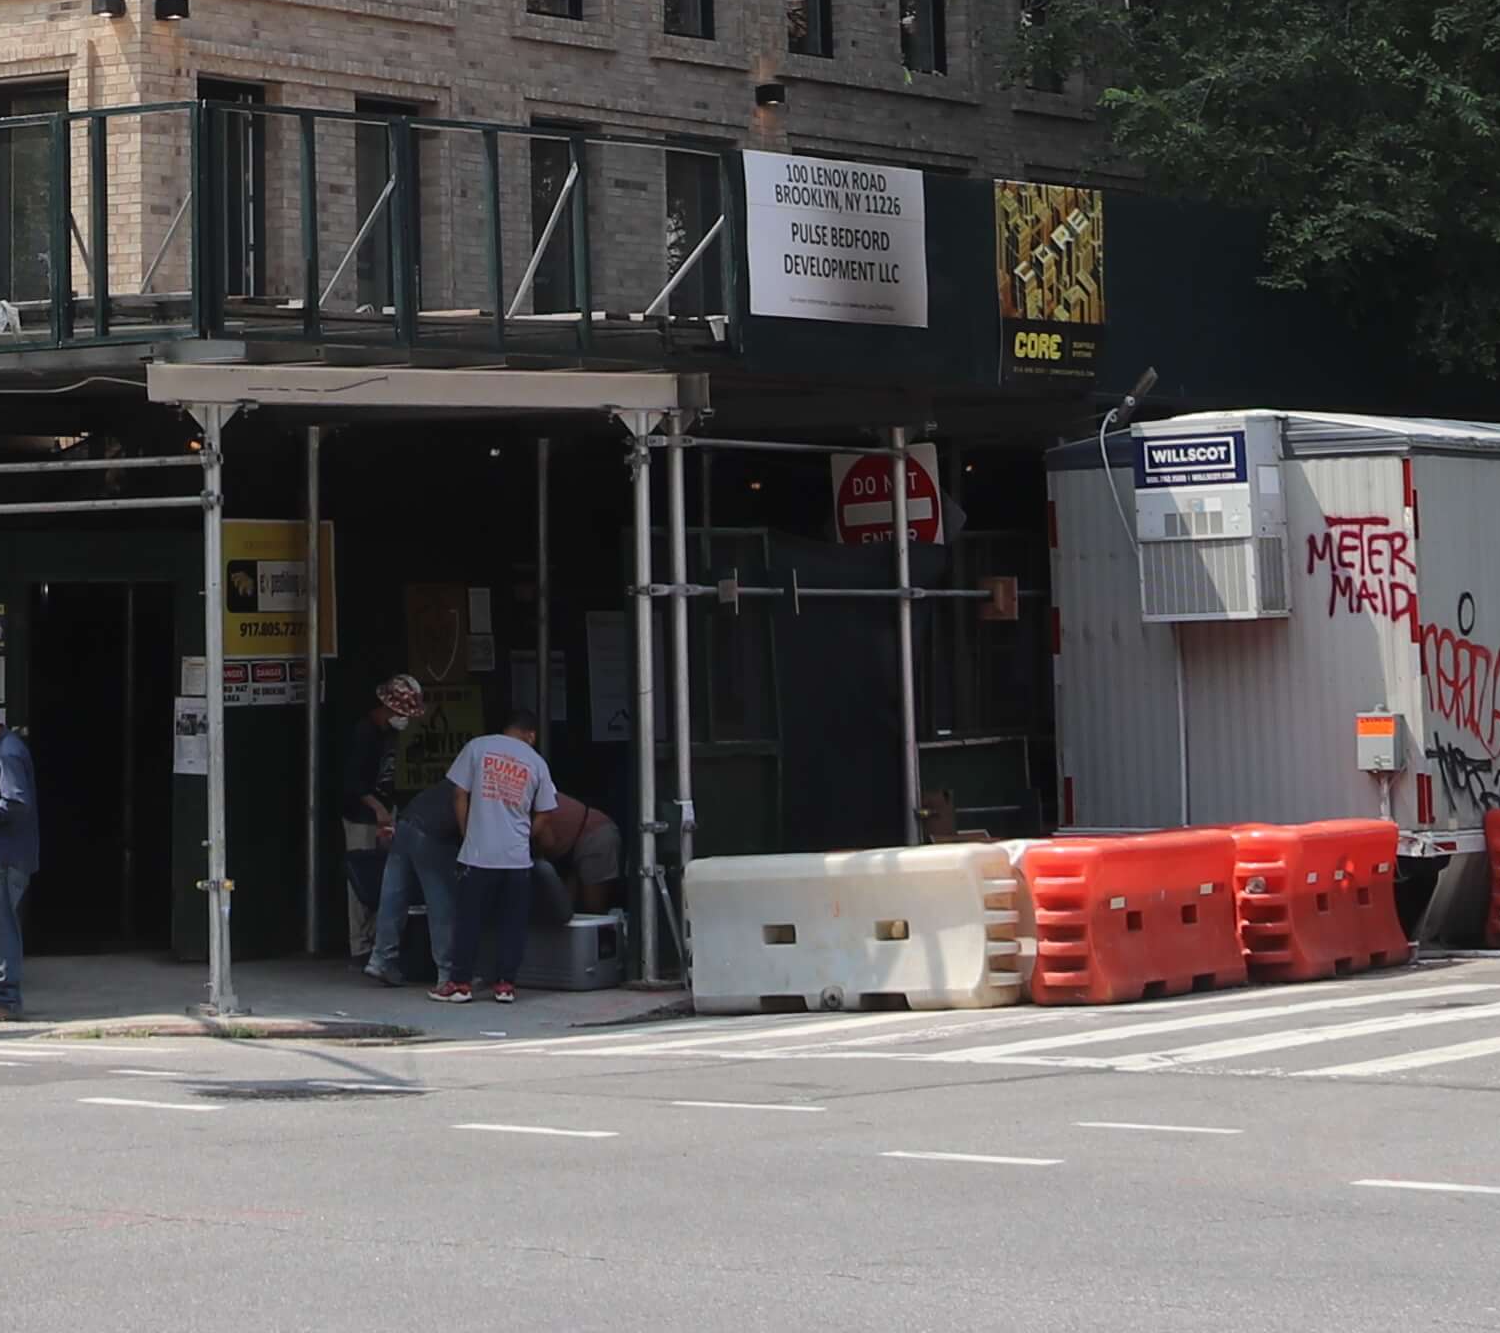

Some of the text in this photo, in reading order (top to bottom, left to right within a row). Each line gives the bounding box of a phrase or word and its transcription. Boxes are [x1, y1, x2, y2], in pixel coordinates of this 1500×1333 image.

[786, 163, 888, 193] 100 LENOX ROAD
[774, 183, 902, 217] BROOKLYN, NY 11226
[791, 222, 891, 252] PULSE BEDFORD
[783, 253, 901, 284] DEVELOPMENT LLC
[1014, 331, 1063, 361] CORE
[1151, 446, 1228, 464] WILLSCOT
[852, 472, 918, 496] DO NT
[1307, 517, 1417, 576] METER
[1329, 573, 1416, 623] MAID
[483, 756, 529, 782] PUMA
